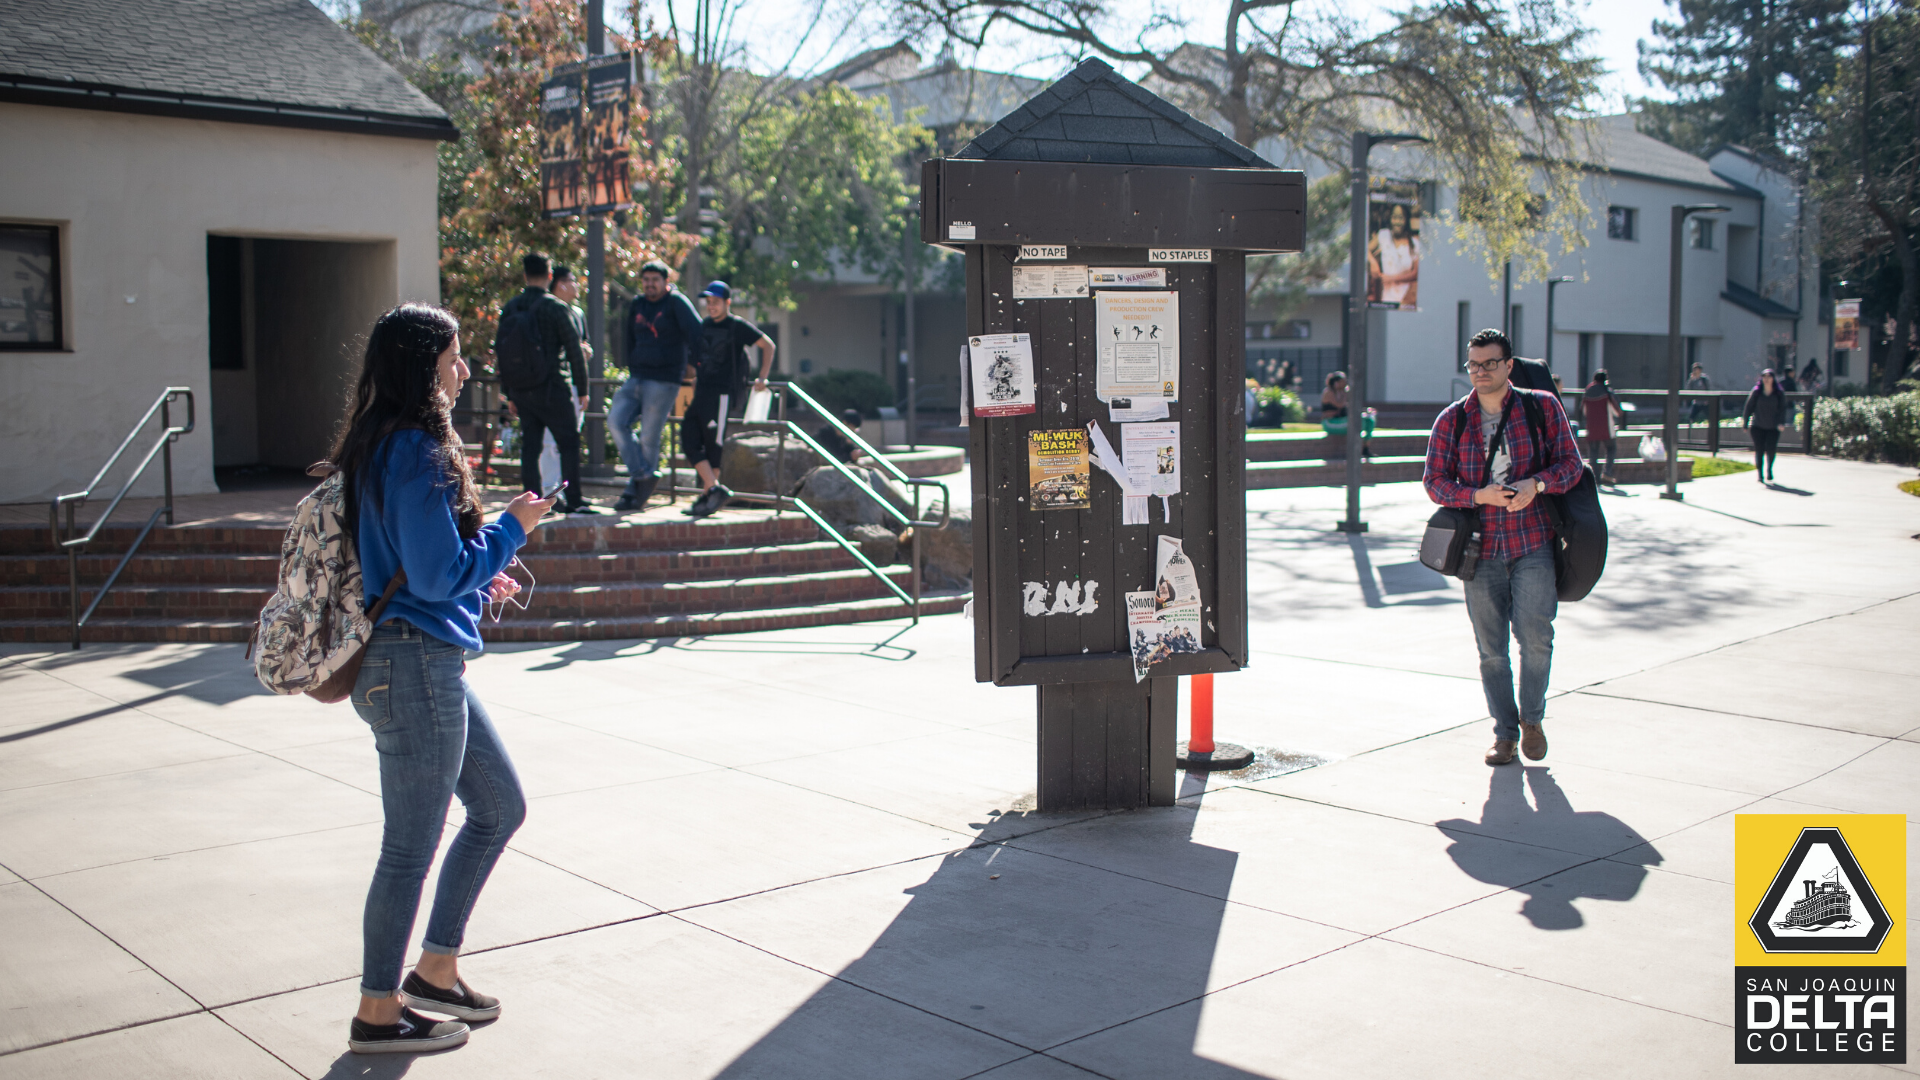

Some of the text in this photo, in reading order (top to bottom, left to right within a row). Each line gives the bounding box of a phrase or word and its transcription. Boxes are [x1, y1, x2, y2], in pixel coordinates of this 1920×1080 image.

[1023, 247, 1066, 257] NO TAPE
[1152, 251, 1209, 260] NO STAPLES
[1125, 270, 1158, 283] WARNING
[1033, 431, 1083, 442] MI-WUK
[1041, 441, 1076, 450] BASH
[1128, 595, 1155, 609] Sonora
